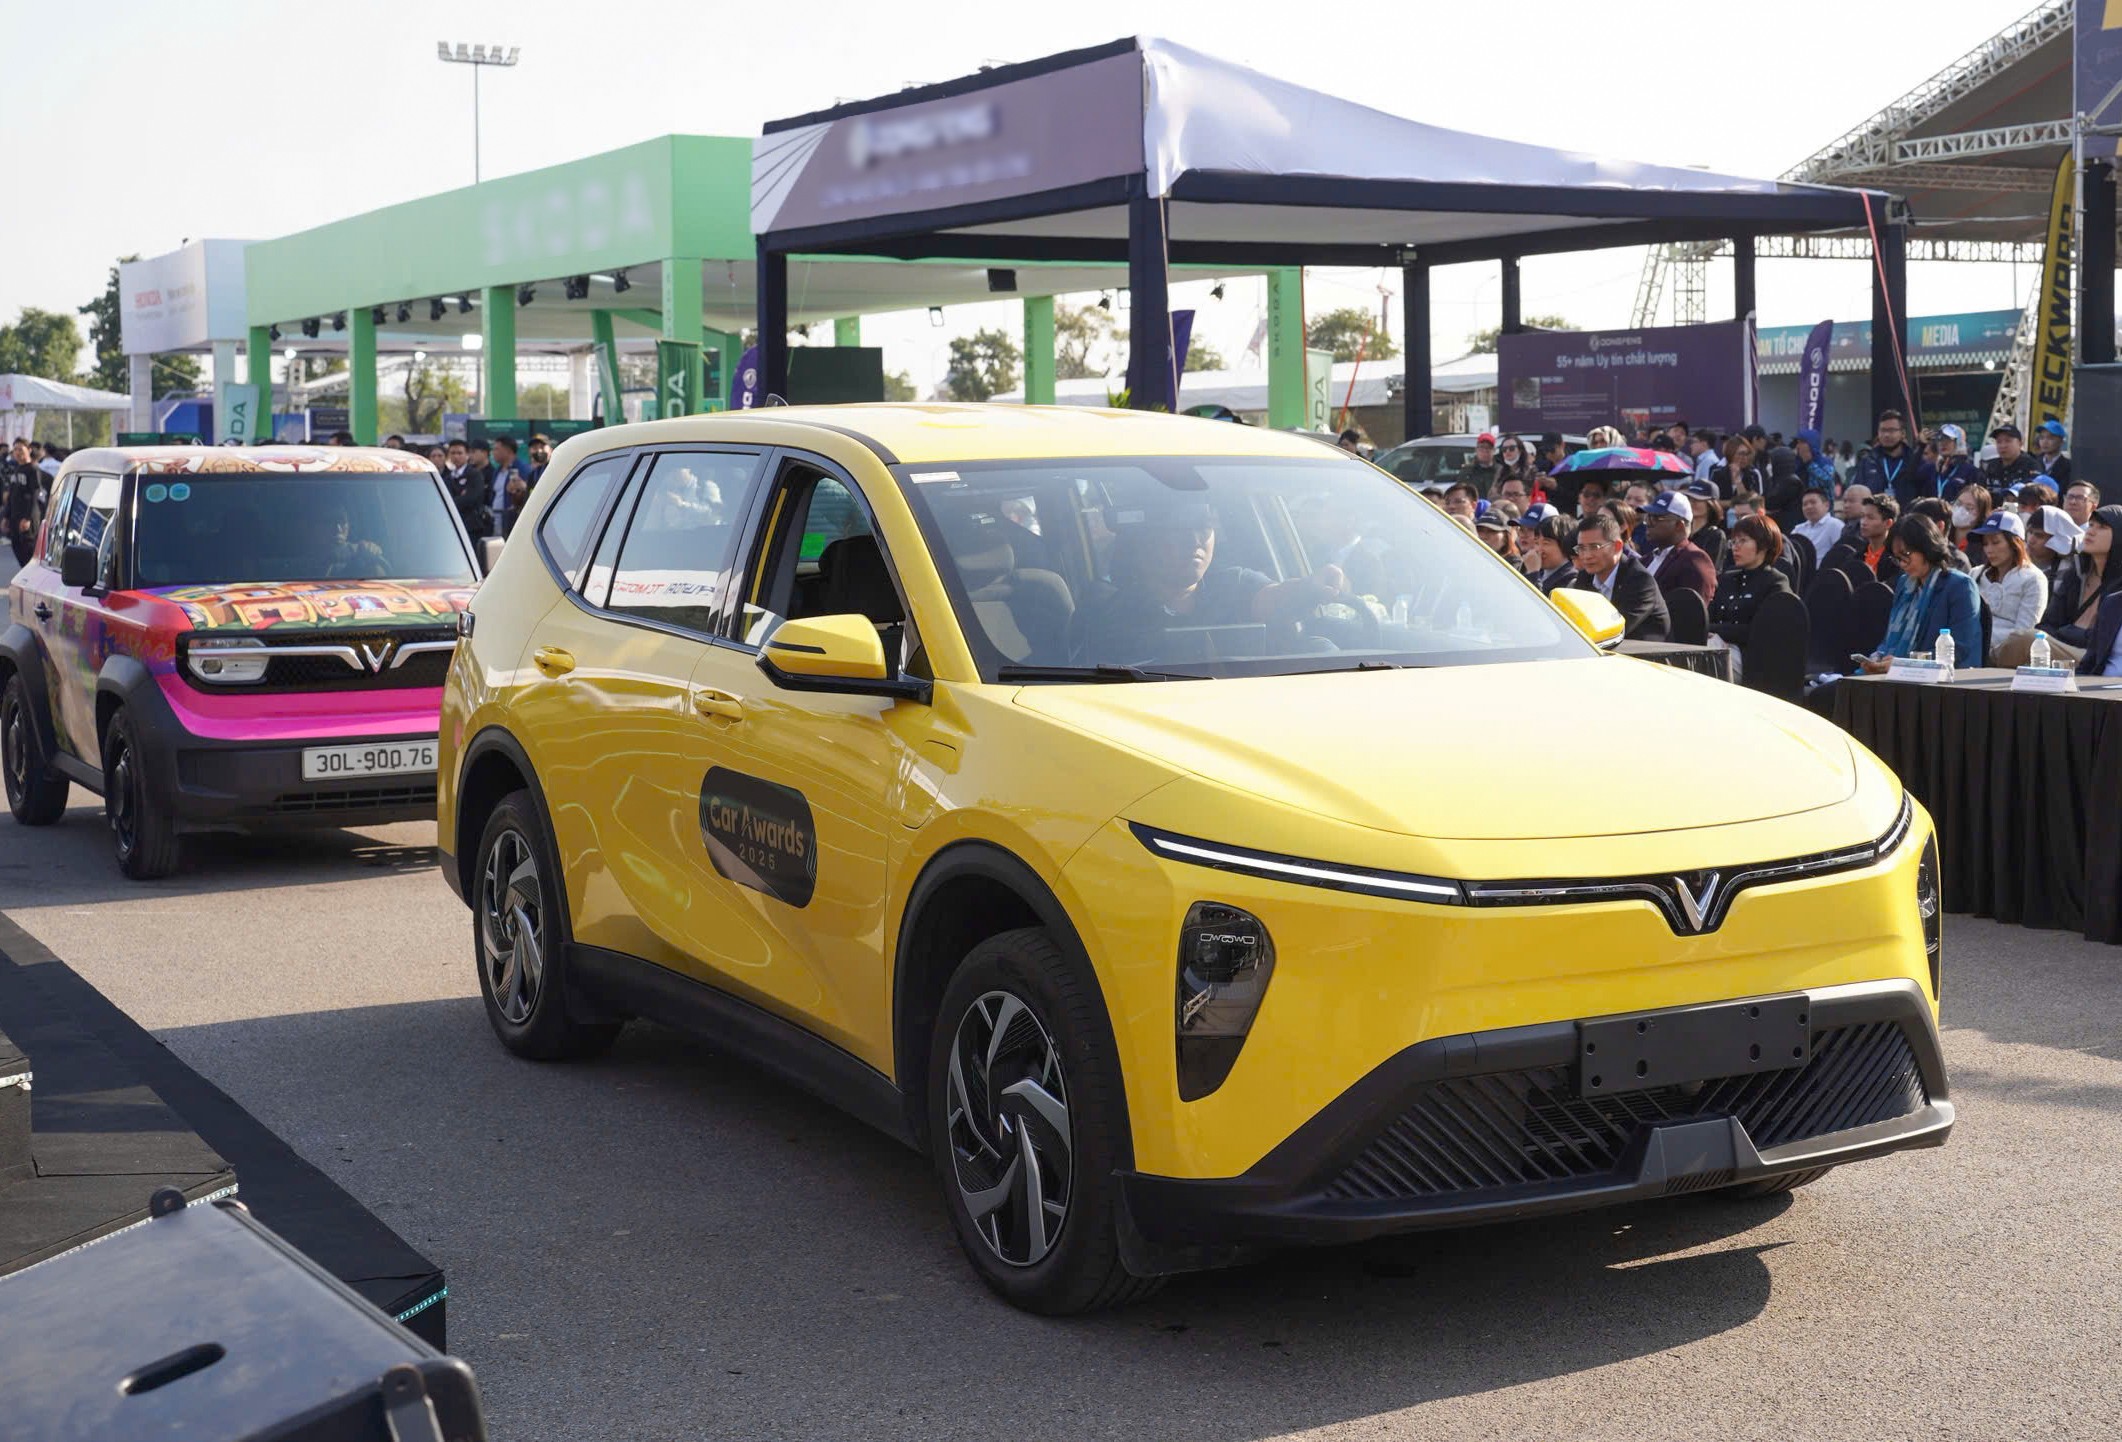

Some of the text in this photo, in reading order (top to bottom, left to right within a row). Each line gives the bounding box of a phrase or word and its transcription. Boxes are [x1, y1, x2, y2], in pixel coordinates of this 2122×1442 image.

[1922, 324, 1959, 347] MEDIA
[1556, 355, 1573, 369] 55+
[1596, 354, 1609, 369] Uy
[316, 747, 434, 773] 30L-900.76
[710, 796, 805, 858] Car Awards
[739, 843, 777, 870] 2025
